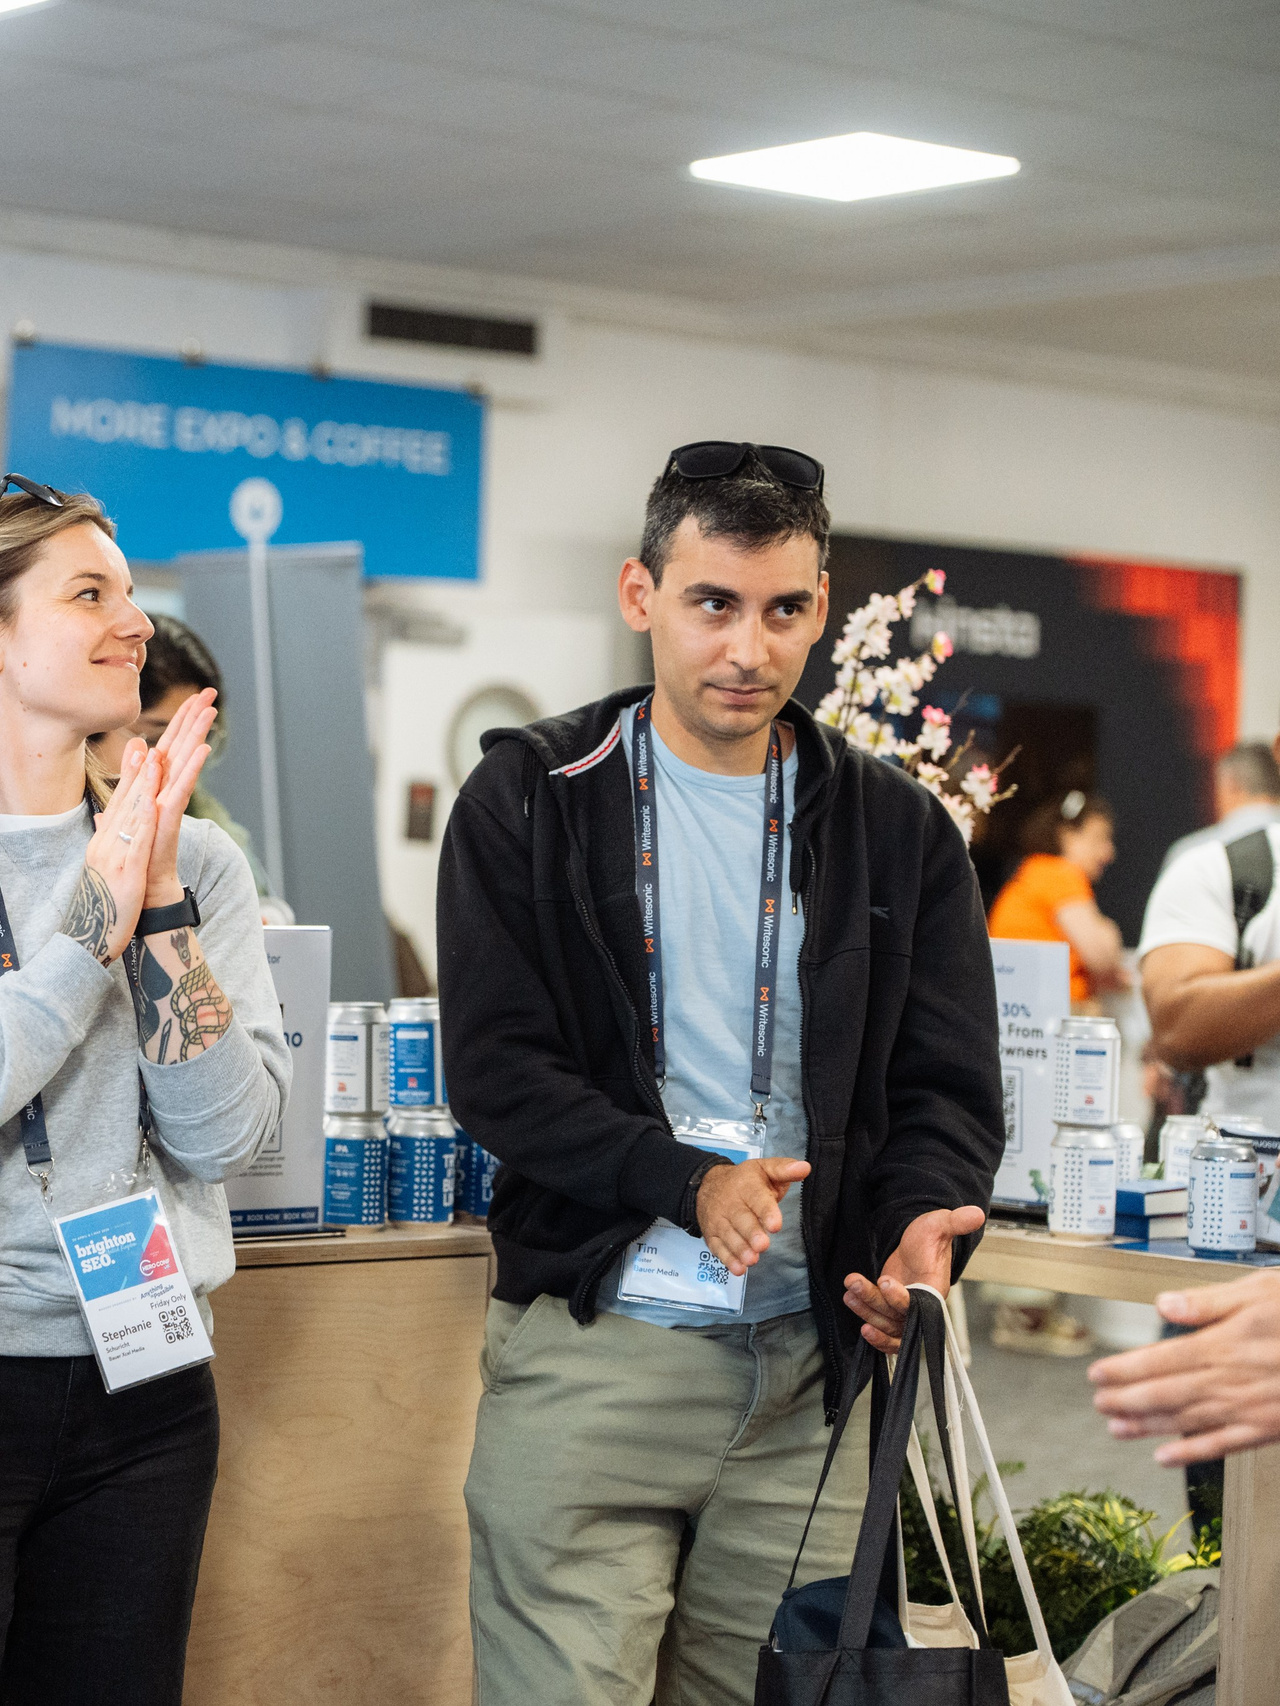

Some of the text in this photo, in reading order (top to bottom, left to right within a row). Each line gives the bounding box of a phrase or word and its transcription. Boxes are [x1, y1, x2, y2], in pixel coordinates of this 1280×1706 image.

[51, 398, 451, 476] MORE EXPO & COFFEE
[638, 732, 648, 778] Writesonic
[769, 759, 779, 804] Writesonic
[642, 805, 650, 851] Writesonic
[766, 834, 778, 882] Writesonic
[643, 883, 653, 937] Writesonic
[761, 915, 775, 968] Writesonic
[649, 971, 658, 1025] Writesonic
[757, 1003, 769, 1057] Writesonic
[1008, 1023, 1044, 1039] From
[74, 1232, 136, 1258] brighton
[636, 1242, 658, 1255] Tim
[80, 1253, 116, 1274] SEO.
[633, 1264, 680, 1278] Bauer Media
[634, 1255, 652, 1264] Foster
[140, 1283, 164, 1300] Anything
[150, 1298, 171, 1310] Friday
[171, 1293, 187, 1304] Only
[101, 1320, 152, 1343] Stephanie
[106, 1341, 131, 1354] Schuricht
[132, 1346, 145, 1354] Media
